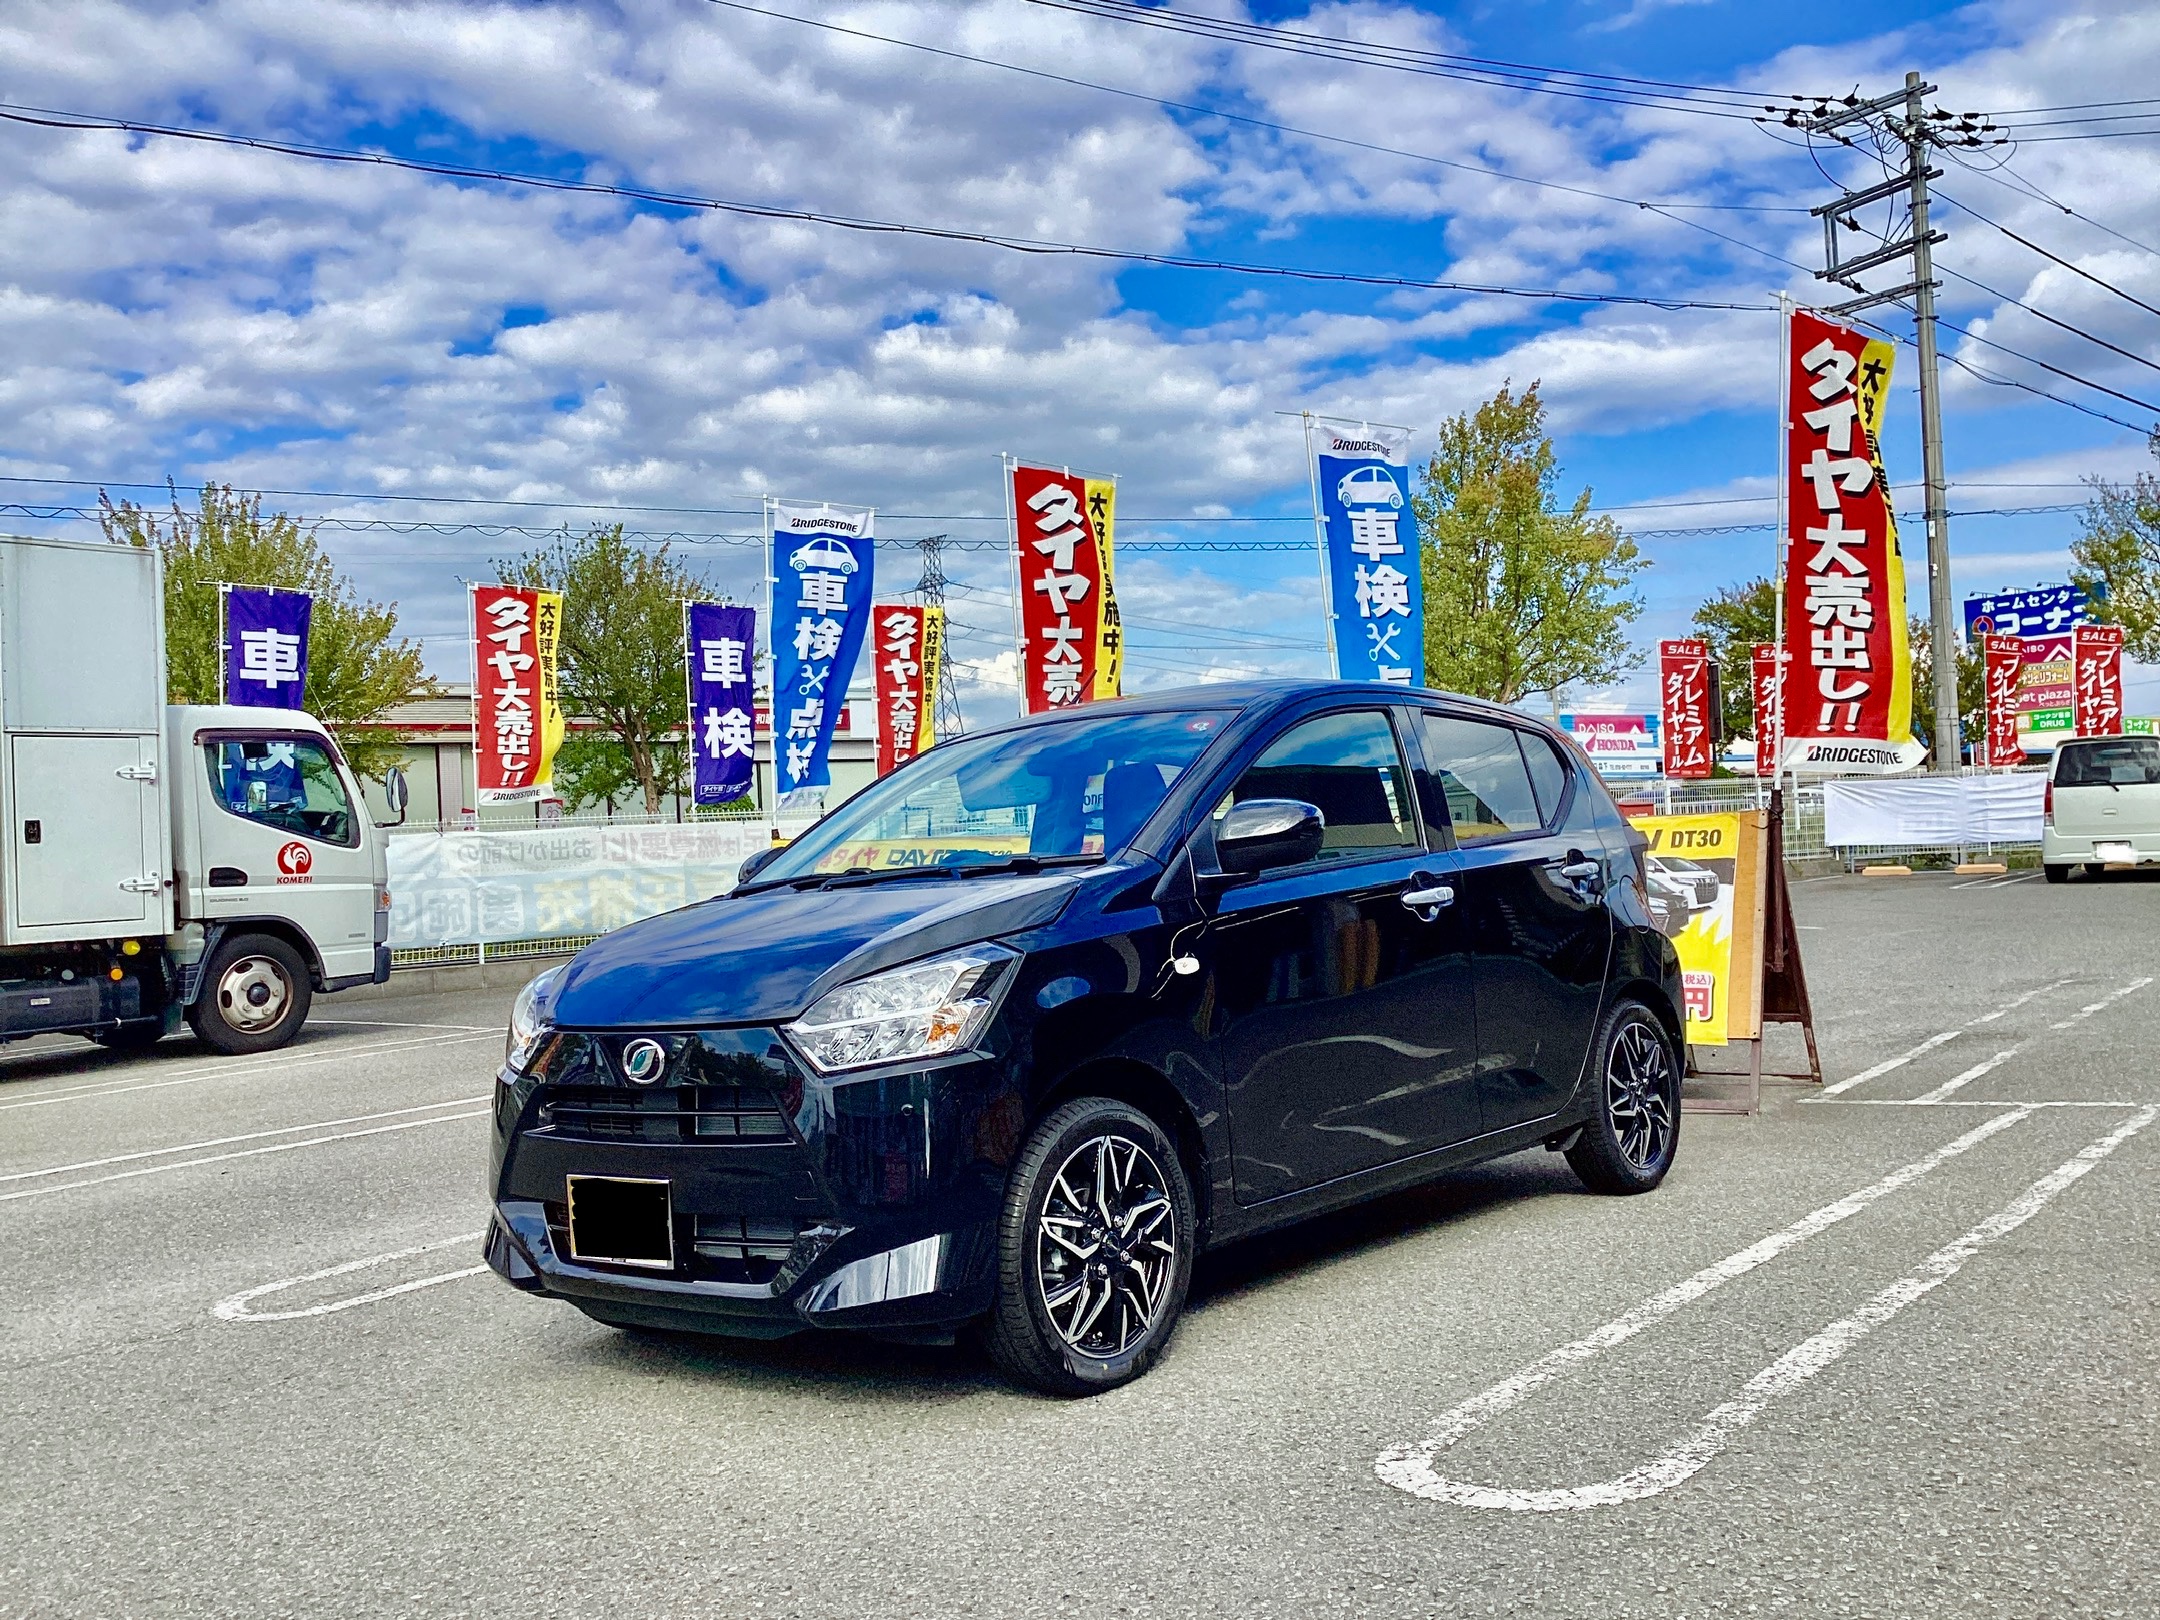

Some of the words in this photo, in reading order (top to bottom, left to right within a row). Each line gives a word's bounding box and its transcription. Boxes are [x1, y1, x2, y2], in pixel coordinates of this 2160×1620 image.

[1331, 438, 1391, 458] BRIDGESTONE
[790, 517, 858, 533] BRIDGESTONE
[1801, 338, 1874, 732] タイヤ大売出し!!
[1347, 507, 1412, 618] 車検
[1026, 482, 1091, 709] タイヤ大売
[1981, 588, 2086, 614] ホームセンター
[792, 570, 849, 662] 車検
[1990, 640, 2020, 652] SALE
[2081, 631, 2118, 643] SALE
[1667, 644, 1703, 656] SALE
[484, 596, 534, 787] タイヤ大売出し!!
[700, 636, 754, 760] 車検
[881, 611, 919, 769] タイヤ大売出し
[2038, 689, 2072, 703] plaza
[1666, 671, 1687, 770] タイヤセール
[1682, 659, 1706, 767] プレミアム
[1578, 723, 1616, 734] DAISO
[2039, 719, 2066, 729] DRUG
[1596, 738, 1637, 752] HONDA
[1806, 744, 1904, 766] BRIDGESTONE
[492, 788, 540, 801] BRIDGESTONE
[1670, 828, 1722, 849] DT30
[276, 875, 314, 885] KOMERI
